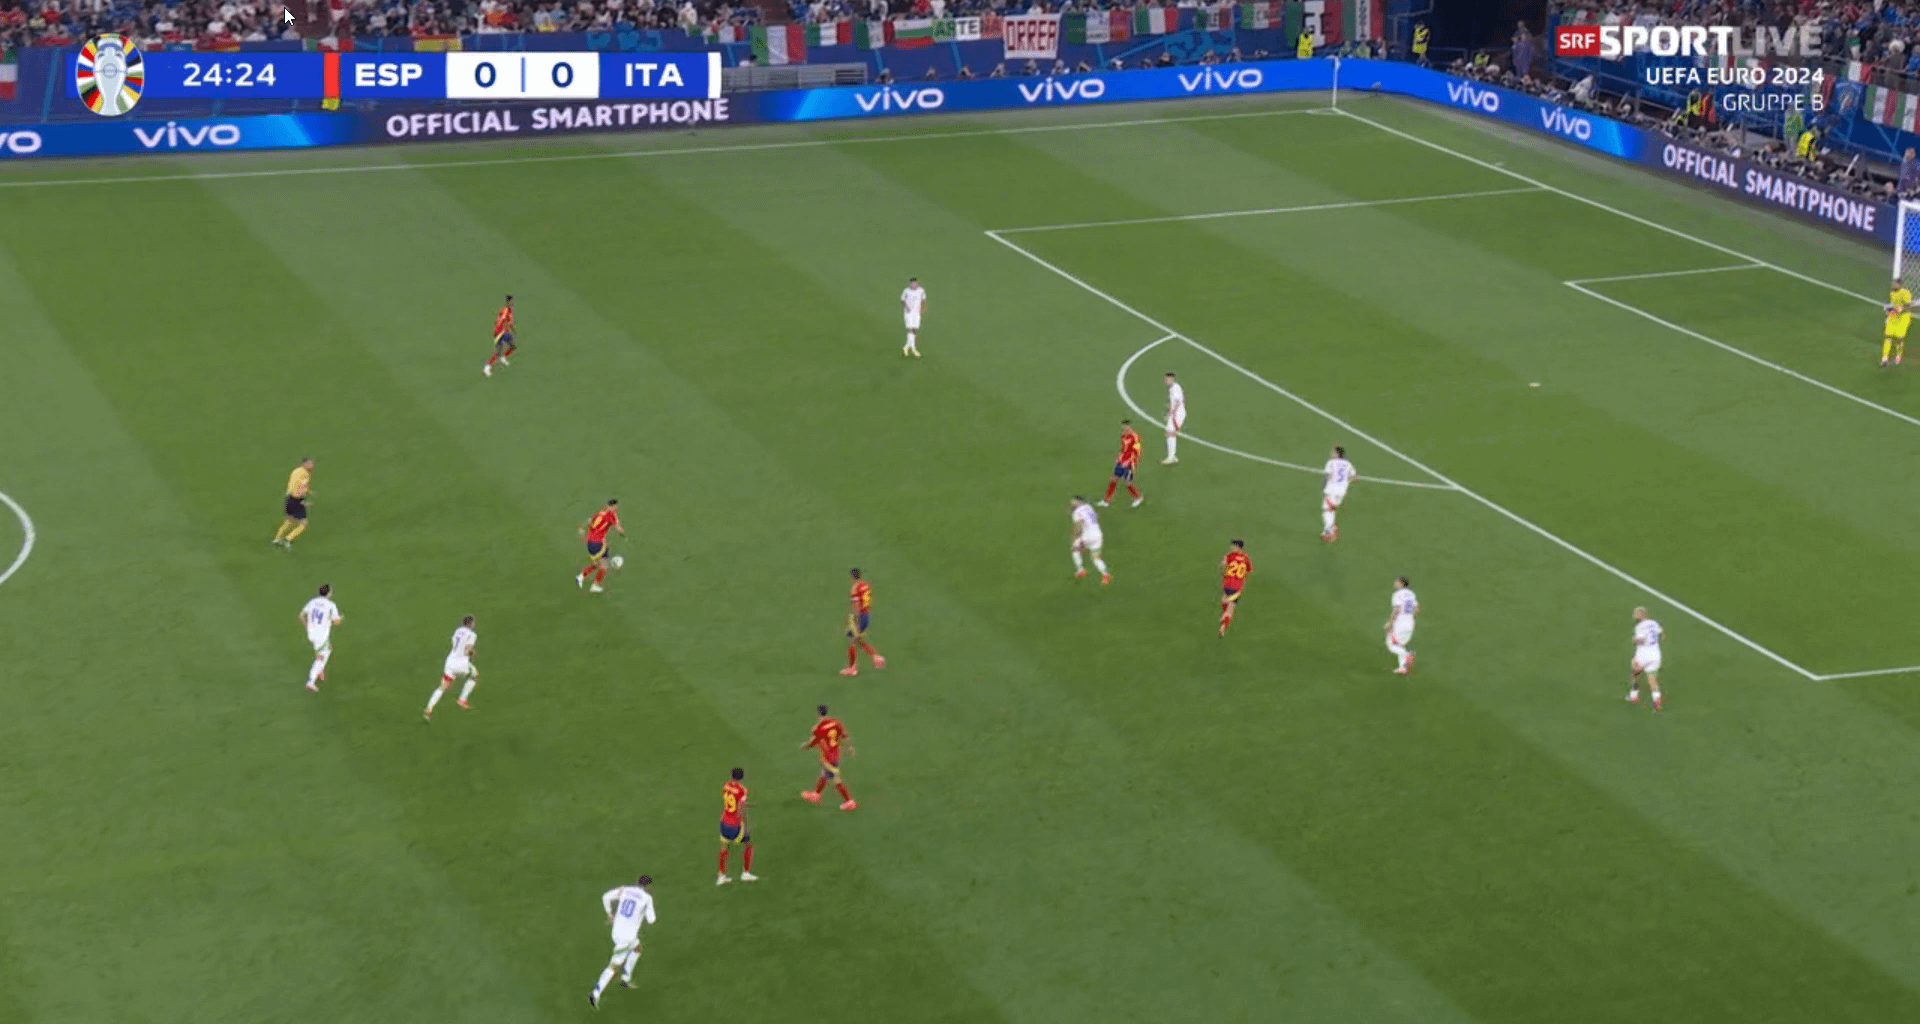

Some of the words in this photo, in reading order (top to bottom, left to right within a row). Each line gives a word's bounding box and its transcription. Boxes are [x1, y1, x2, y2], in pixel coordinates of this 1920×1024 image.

[386, 108, 520, 138] OFFICIAL
[531, 97, 730, 131] SMARTPHONE
[1662, 143, 1738, 189] OFFICIAL
[1744, 170, 1877, 232] SMARTPHONE
[1228, 561, 1247, 579] 20
[620, 898, 637, 918] 10
